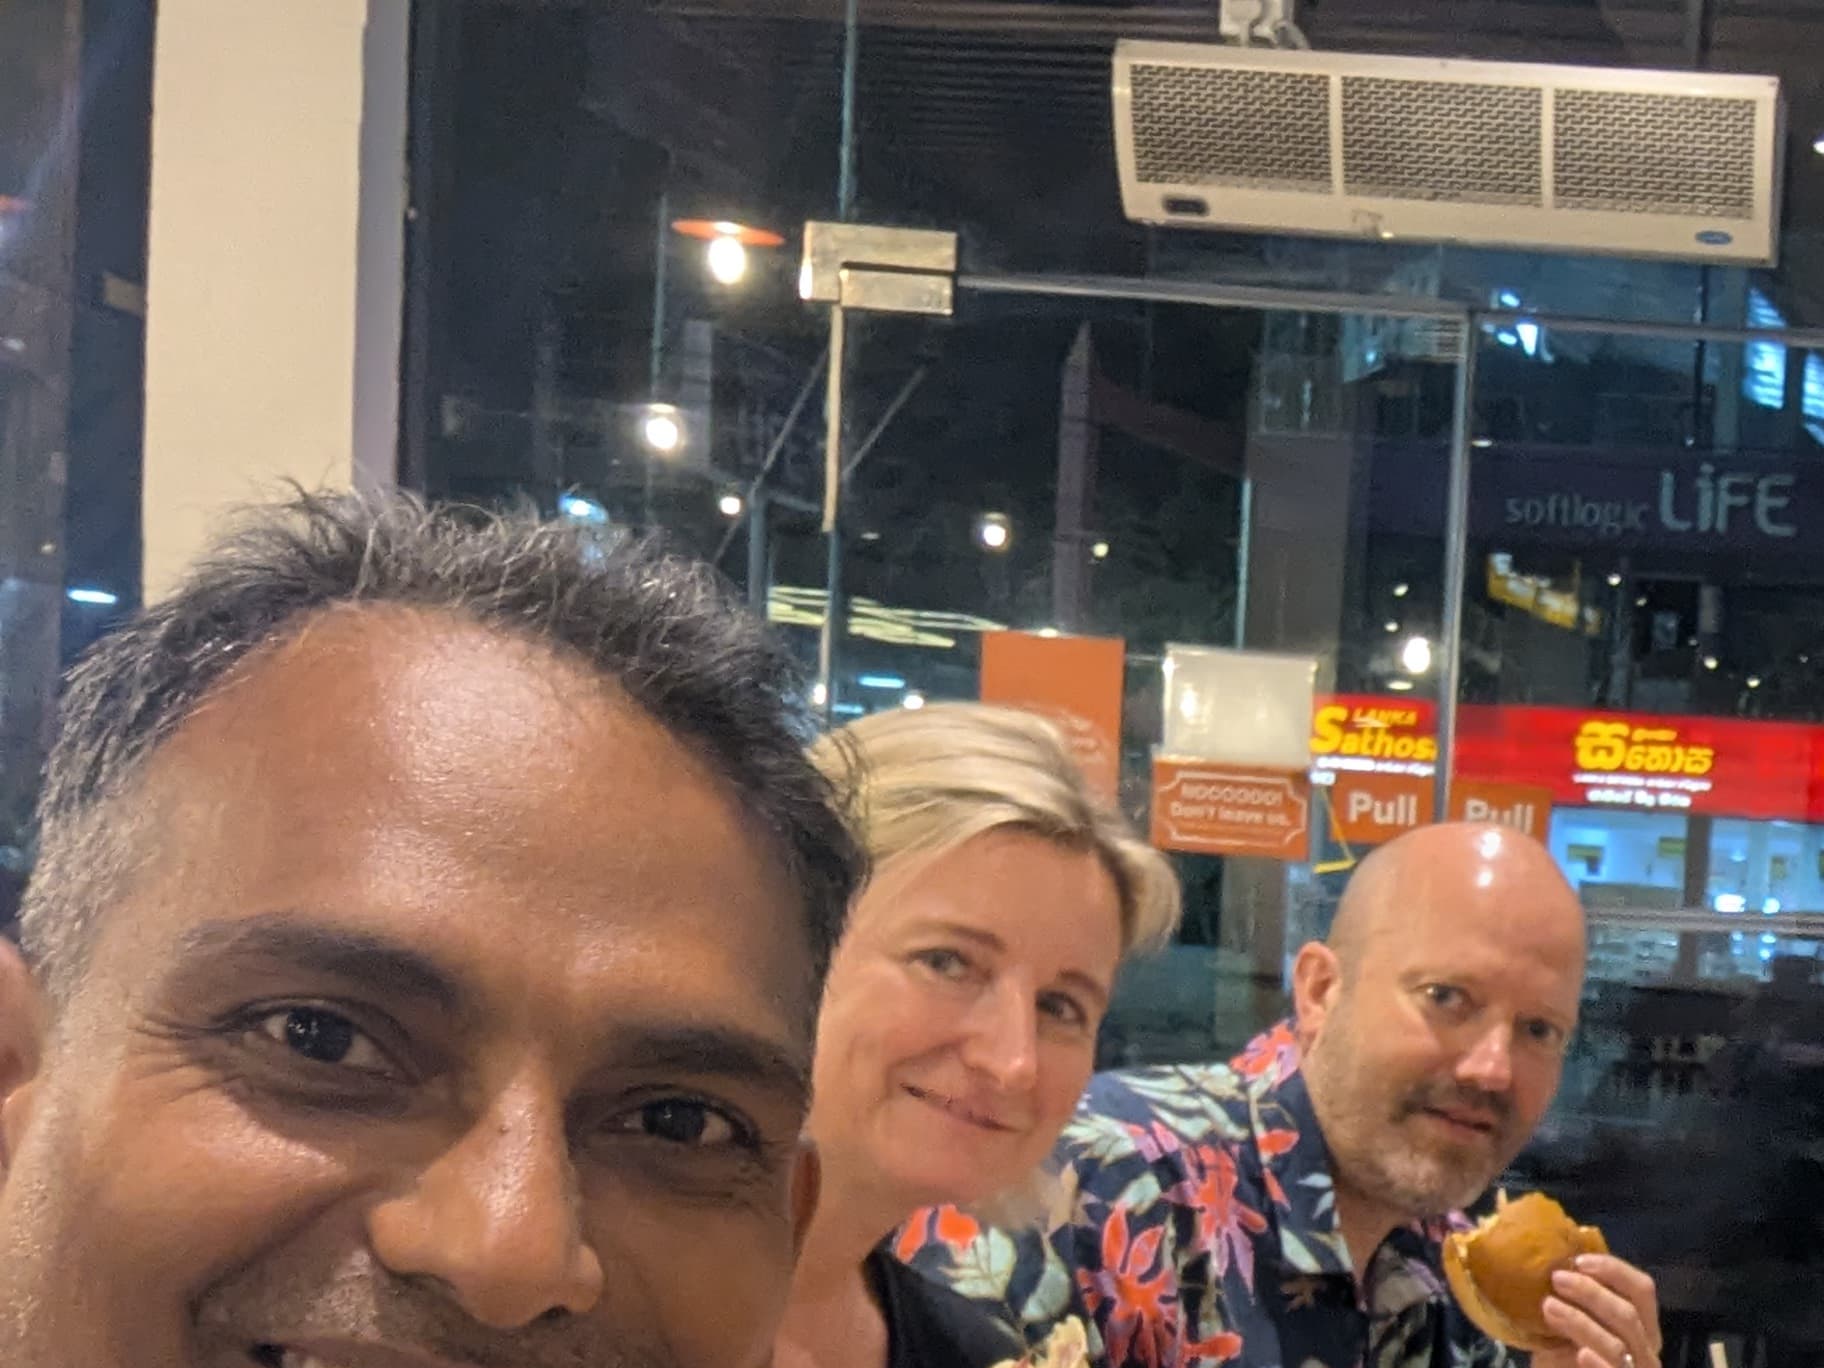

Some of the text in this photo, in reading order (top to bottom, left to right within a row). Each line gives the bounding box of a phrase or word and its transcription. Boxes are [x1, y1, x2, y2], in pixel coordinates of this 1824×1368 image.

[1504, 492, 1649, 537] softlogic
[1348, 791, 1418, 827] Pull
[1465, 798, 1534, 835] Pull
